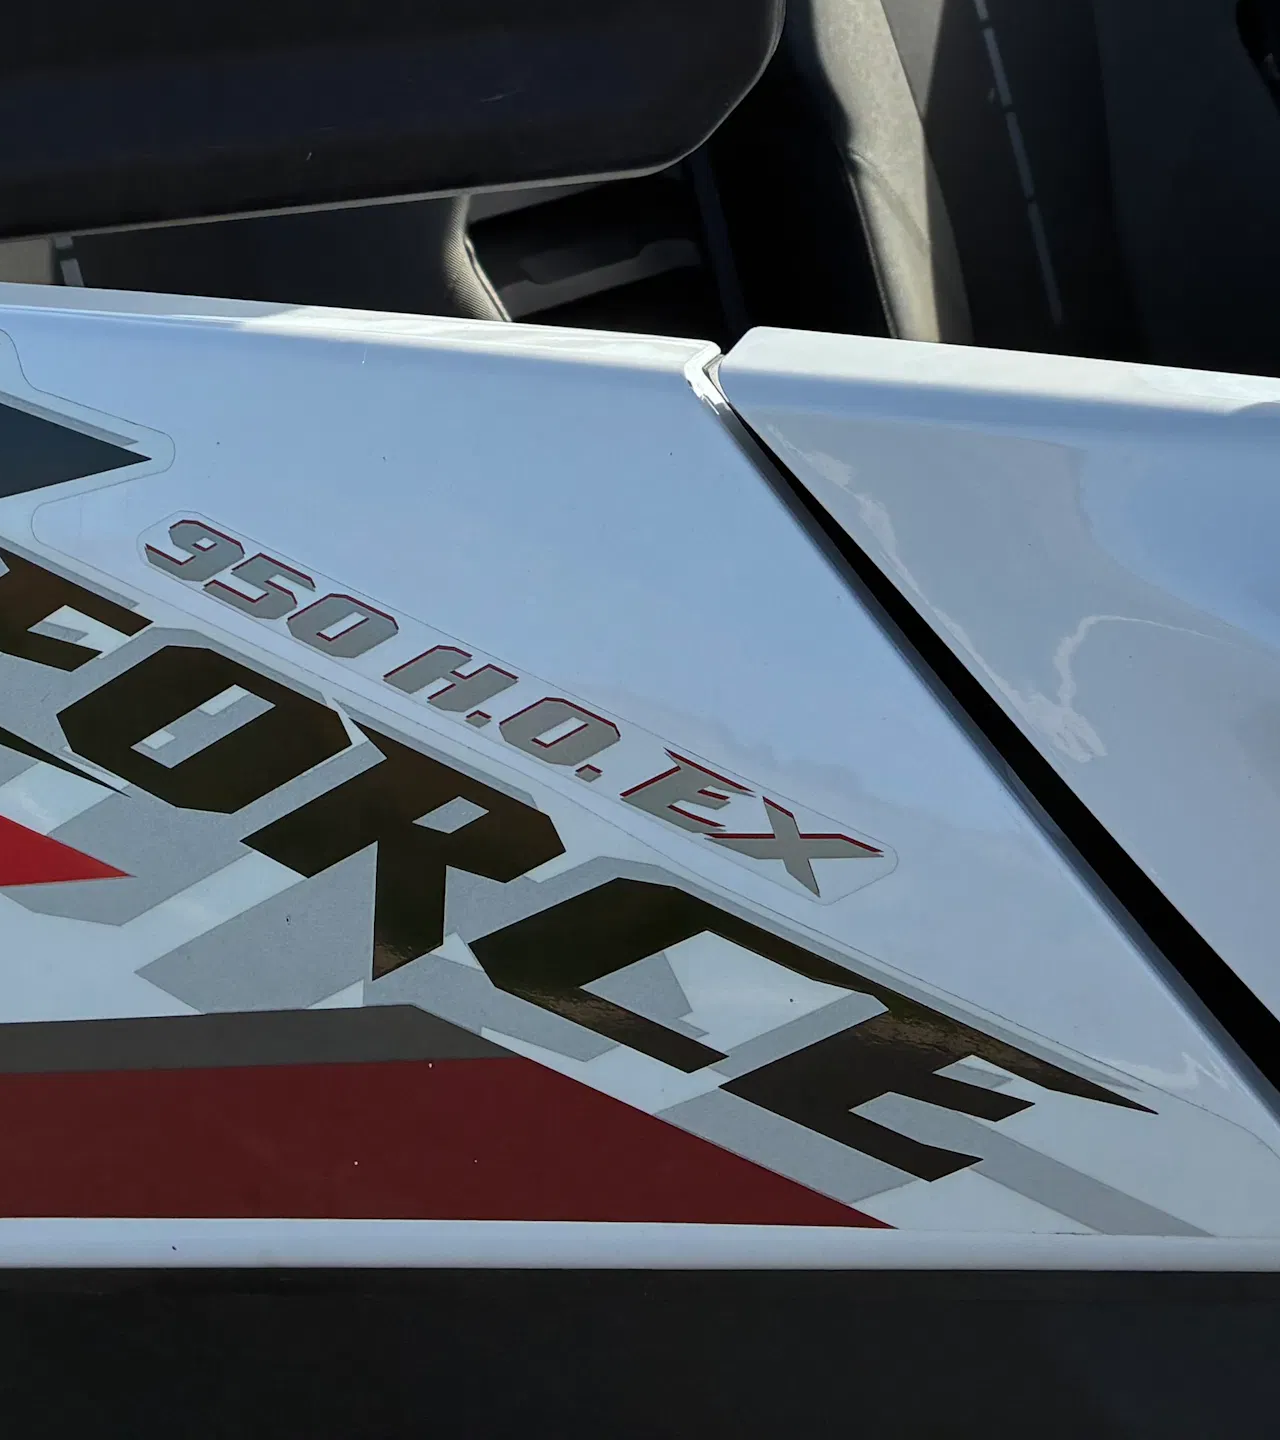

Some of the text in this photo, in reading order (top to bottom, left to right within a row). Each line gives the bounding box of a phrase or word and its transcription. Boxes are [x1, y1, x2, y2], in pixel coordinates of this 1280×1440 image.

[144, 518, 884, 898] 950 H.O. EX
